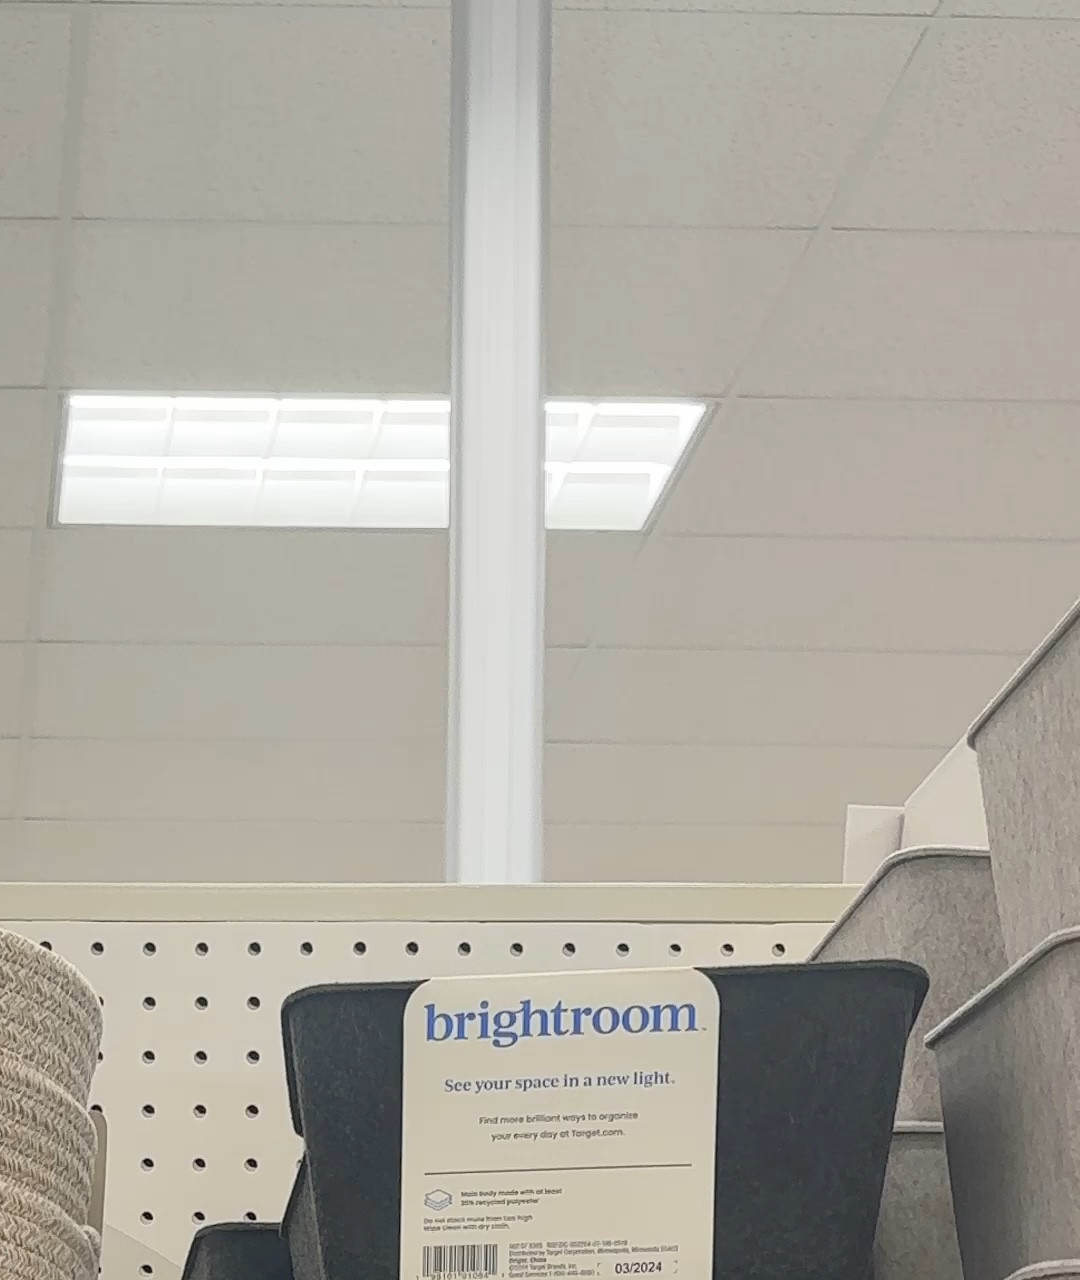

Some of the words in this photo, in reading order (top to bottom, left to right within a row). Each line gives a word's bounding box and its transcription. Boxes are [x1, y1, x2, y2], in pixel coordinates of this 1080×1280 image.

[424, 999, 698, 1048] brightroom
[444, 1078, 472, 1093] See
[475, 1079, 512, 1094] your
[515, 1077, 560, 1092] space
[563, 1073, 580, 1088] in
[583, 1076, 593, 1087] a
[597, 1073, 630, 1087] new
[633, 1070, 676, 1088] light.
[478, 1116, 498, 1125] Find
[500, 1116, 524, 1124] more
[587, 1112, 597, 1121] to
[599, 1111, 639, 1123] organize
[491, 1132, 511, 1143] your
[540, 1130, 558, 1140] day
[560, 1130, 570, 1138] at
[614, 1261, 662, 1275] 03/2024
